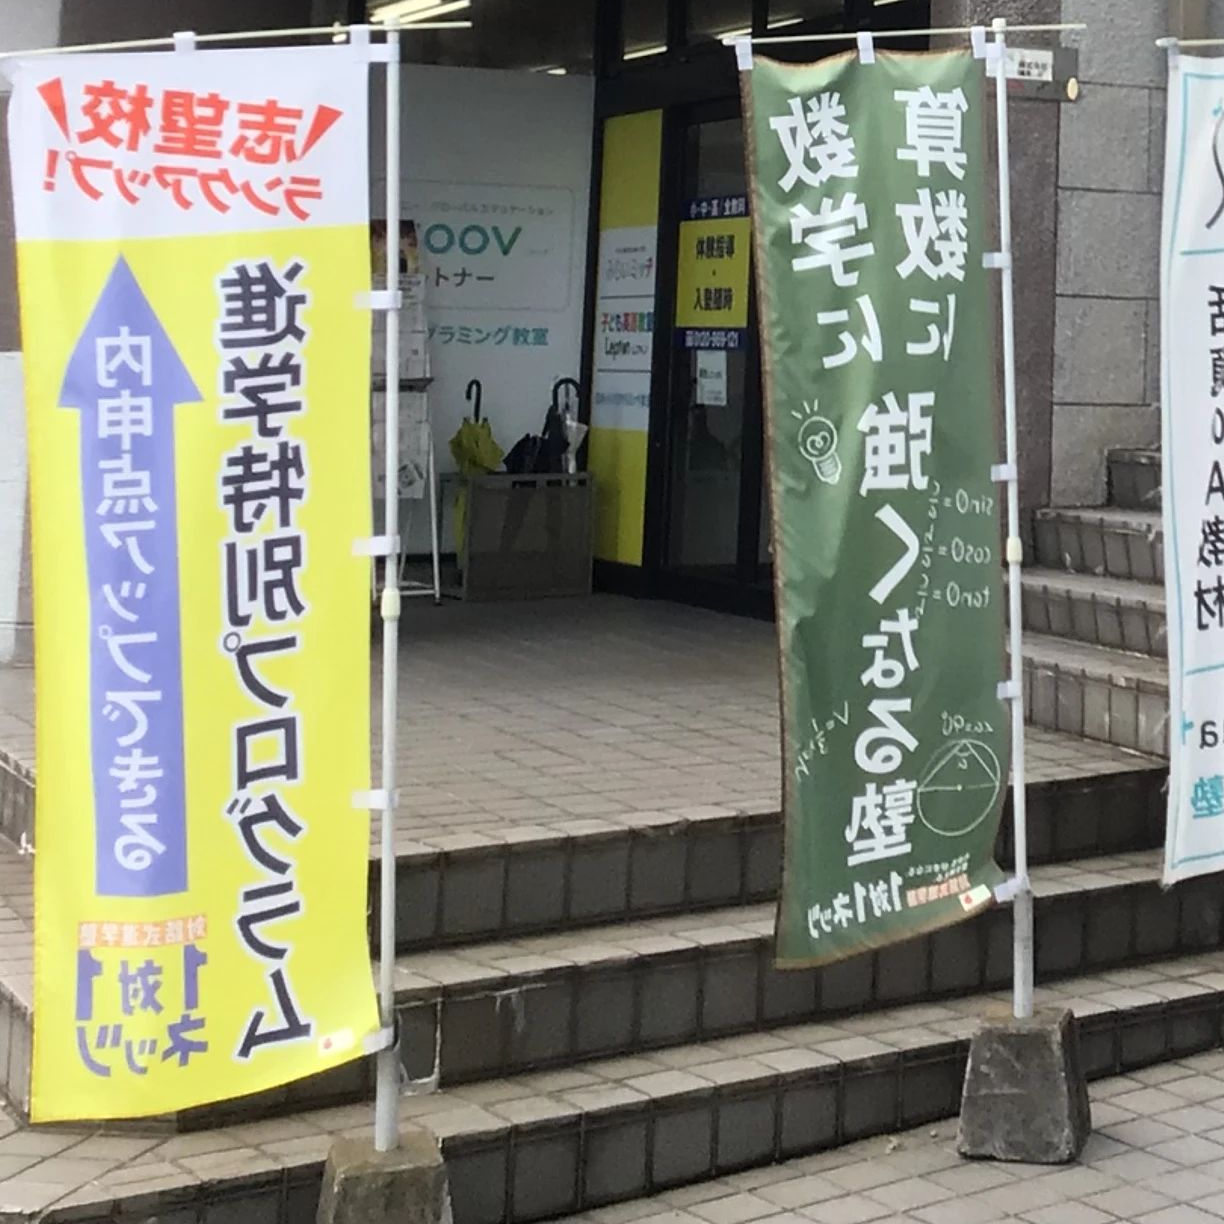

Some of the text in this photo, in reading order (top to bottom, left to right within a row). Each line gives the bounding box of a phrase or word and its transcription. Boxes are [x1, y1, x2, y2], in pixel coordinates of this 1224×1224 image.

[424, 223, 523, 257] OOV
[427, 266, 496, 288] トナー
